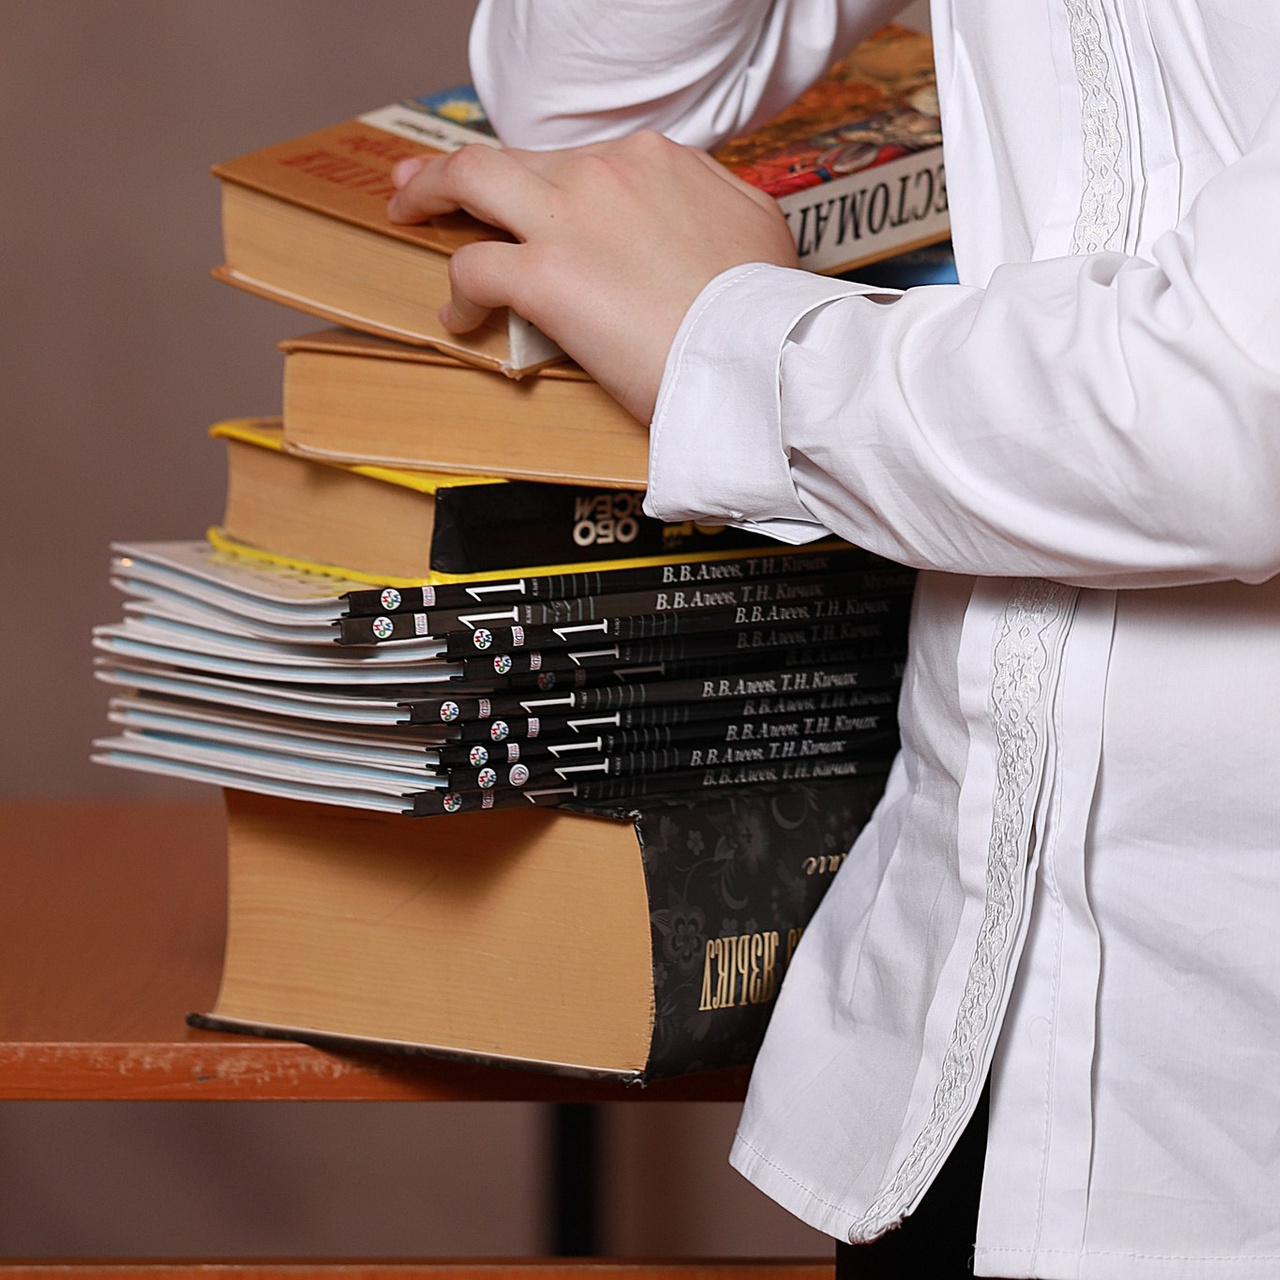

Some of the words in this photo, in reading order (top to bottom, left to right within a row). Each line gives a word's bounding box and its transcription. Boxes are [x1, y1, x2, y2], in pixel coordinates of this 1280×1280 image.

[785, 164, 949, 258] ЕСТОМАТ
[573, 518, 638, 548] ОБО
[465, 579, 526, 601] 1
[458, 606, 519, 629] 1
[552, 618, 608, 641] 1
[568, 644, 620, 666] 1
[519, 692, 575, 713] 1
[567, 711, 620, 733] 1
[547, 736, 602, 758] 1
[554, 757, 609, 780] 1
[523, 783, 578, 803] 1
[698, 931, 779, 1010] ЯЗЫКУ
